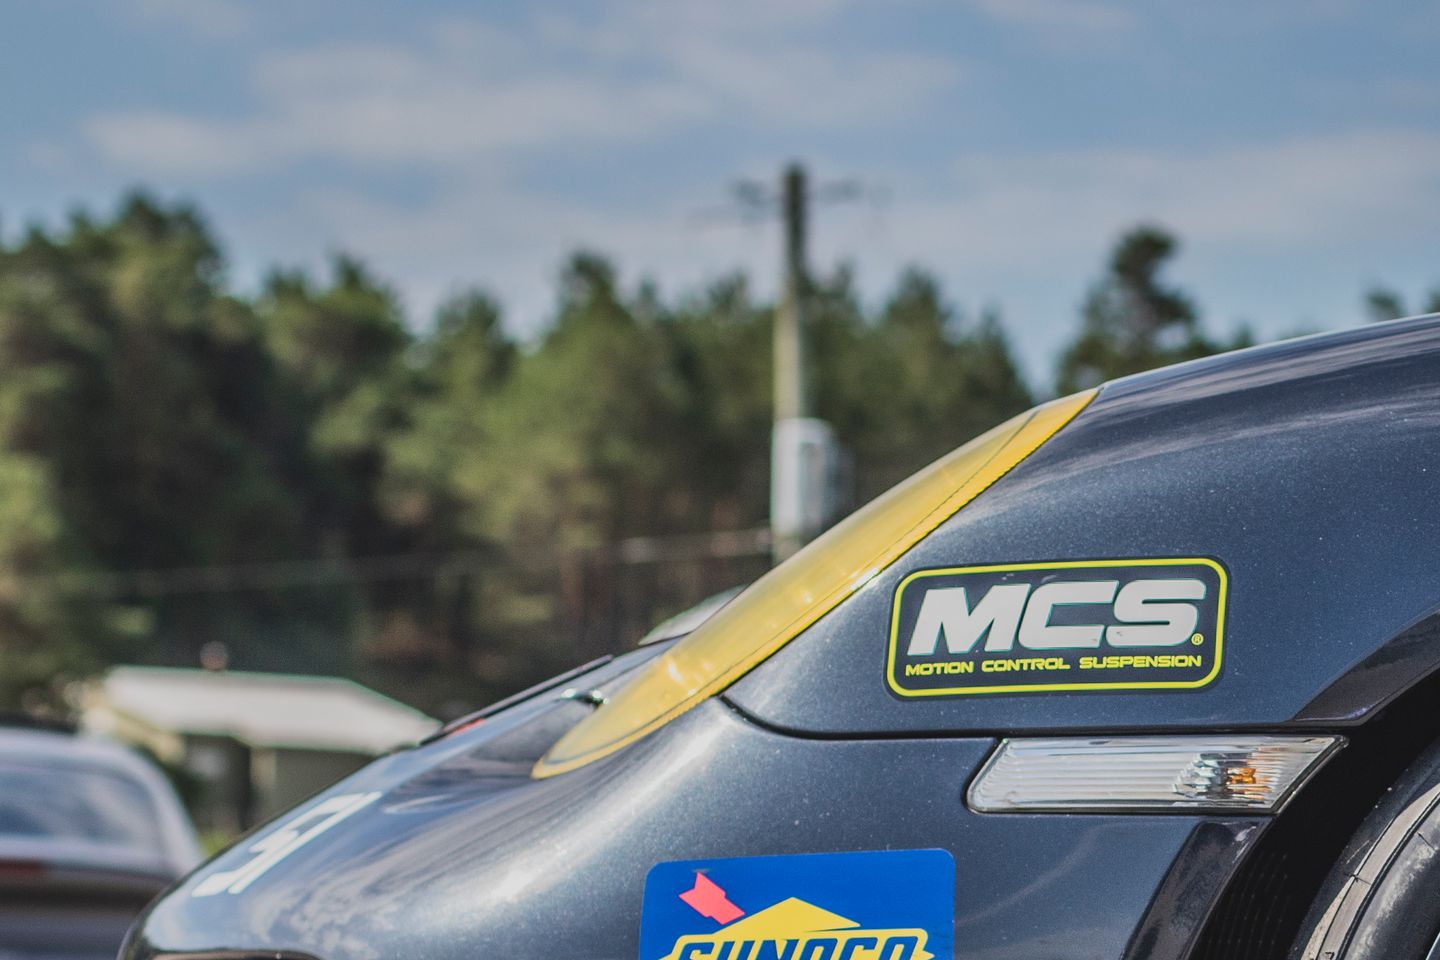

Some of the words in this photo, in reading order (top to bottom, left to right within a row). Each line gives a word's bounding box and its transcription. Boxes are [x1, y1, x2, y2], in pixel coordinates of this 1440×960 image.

[907, 579, 1206, 656] MCS
[905, 661, 974, 677] MOTION
[981, 657, 1071, 672] CONTROL
[1079, 654, 1202, 670] SUSPENSION
